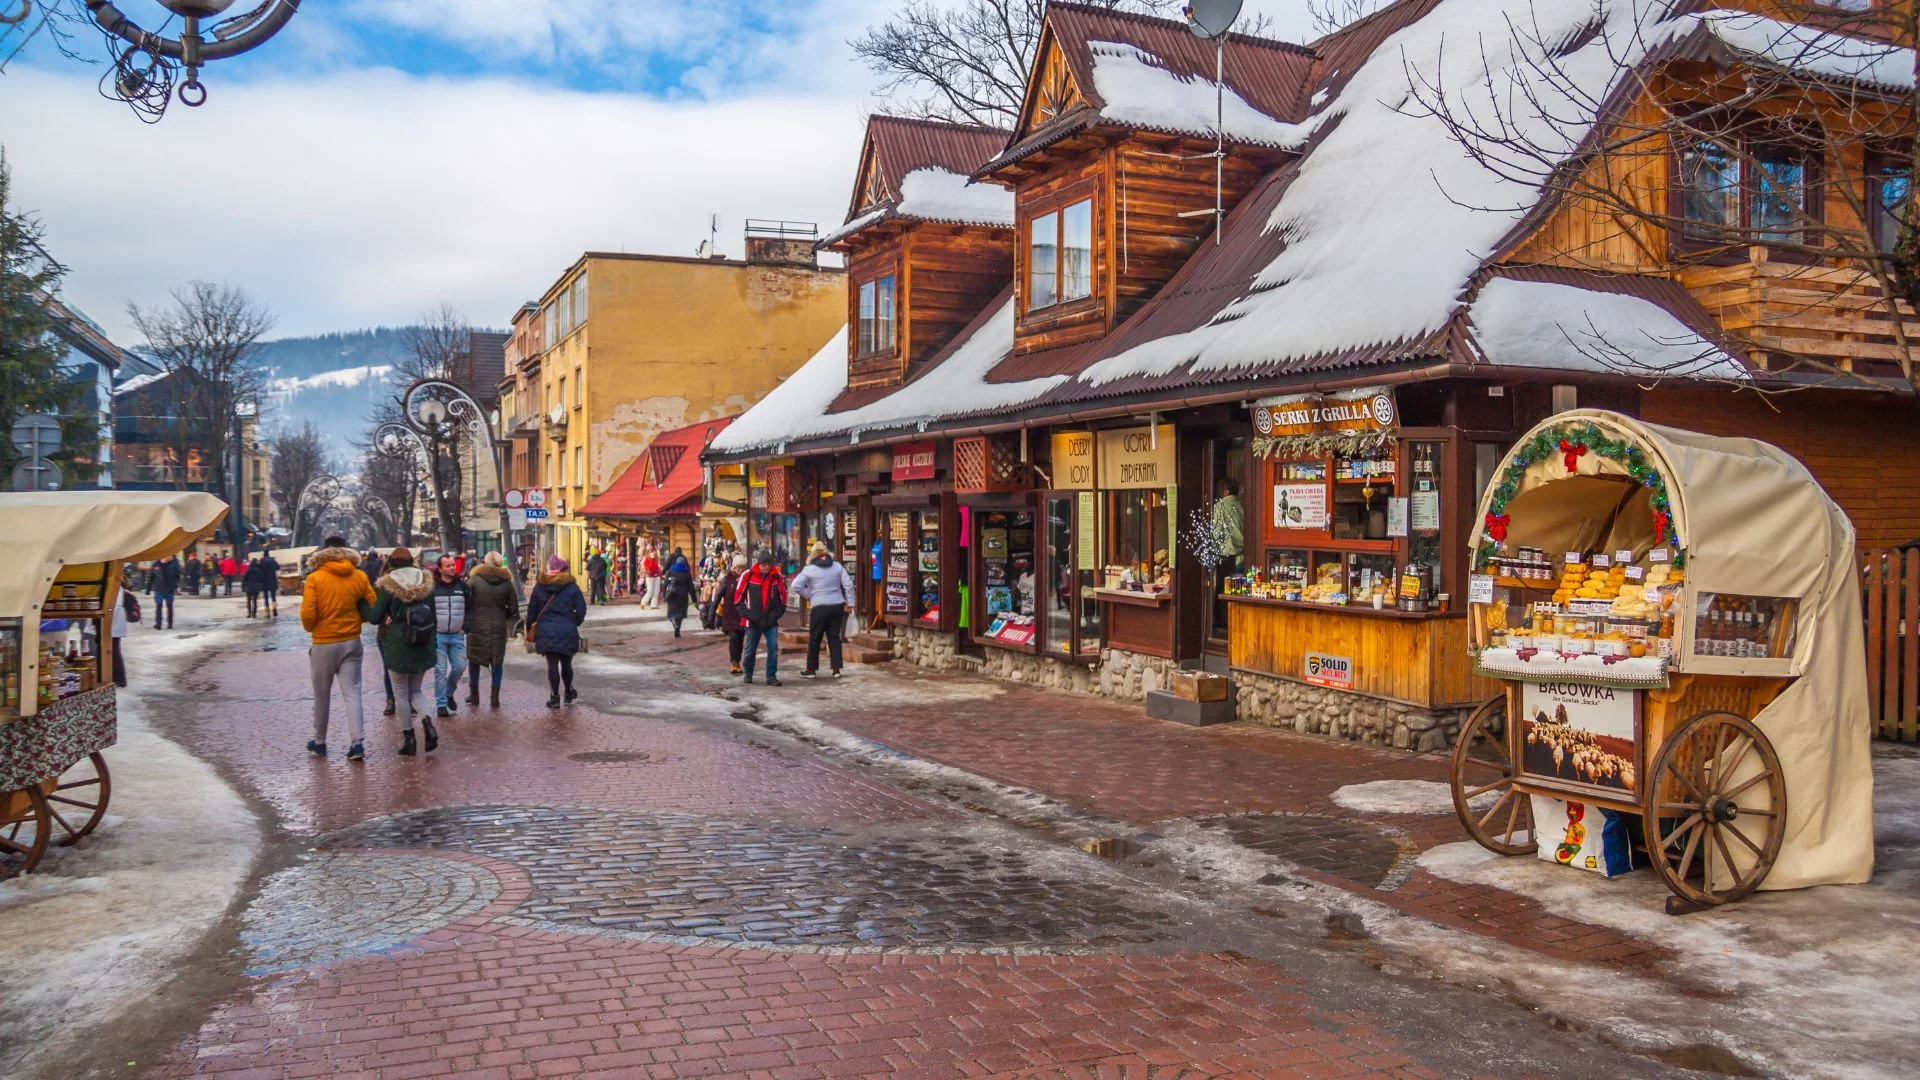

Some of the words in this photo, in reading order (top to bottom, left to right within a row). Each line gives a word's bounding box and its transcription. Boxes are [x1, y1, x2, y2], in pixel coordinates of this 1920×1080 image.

[1273, 410, 1310, 426] SERKI
[1312, 409, 1320, 423] Z
[1321, 404, 1372, 422] GRILLA
[1068, 438, 1091, 456] DESERY
[1124, 433, 1151, 452] GOFRY
[1070, 465, 1090, 483] LODY
[1120, 462, 1158, 483] ZAPIEKANKI
[1321, 658, 1347, 671] SOLID
